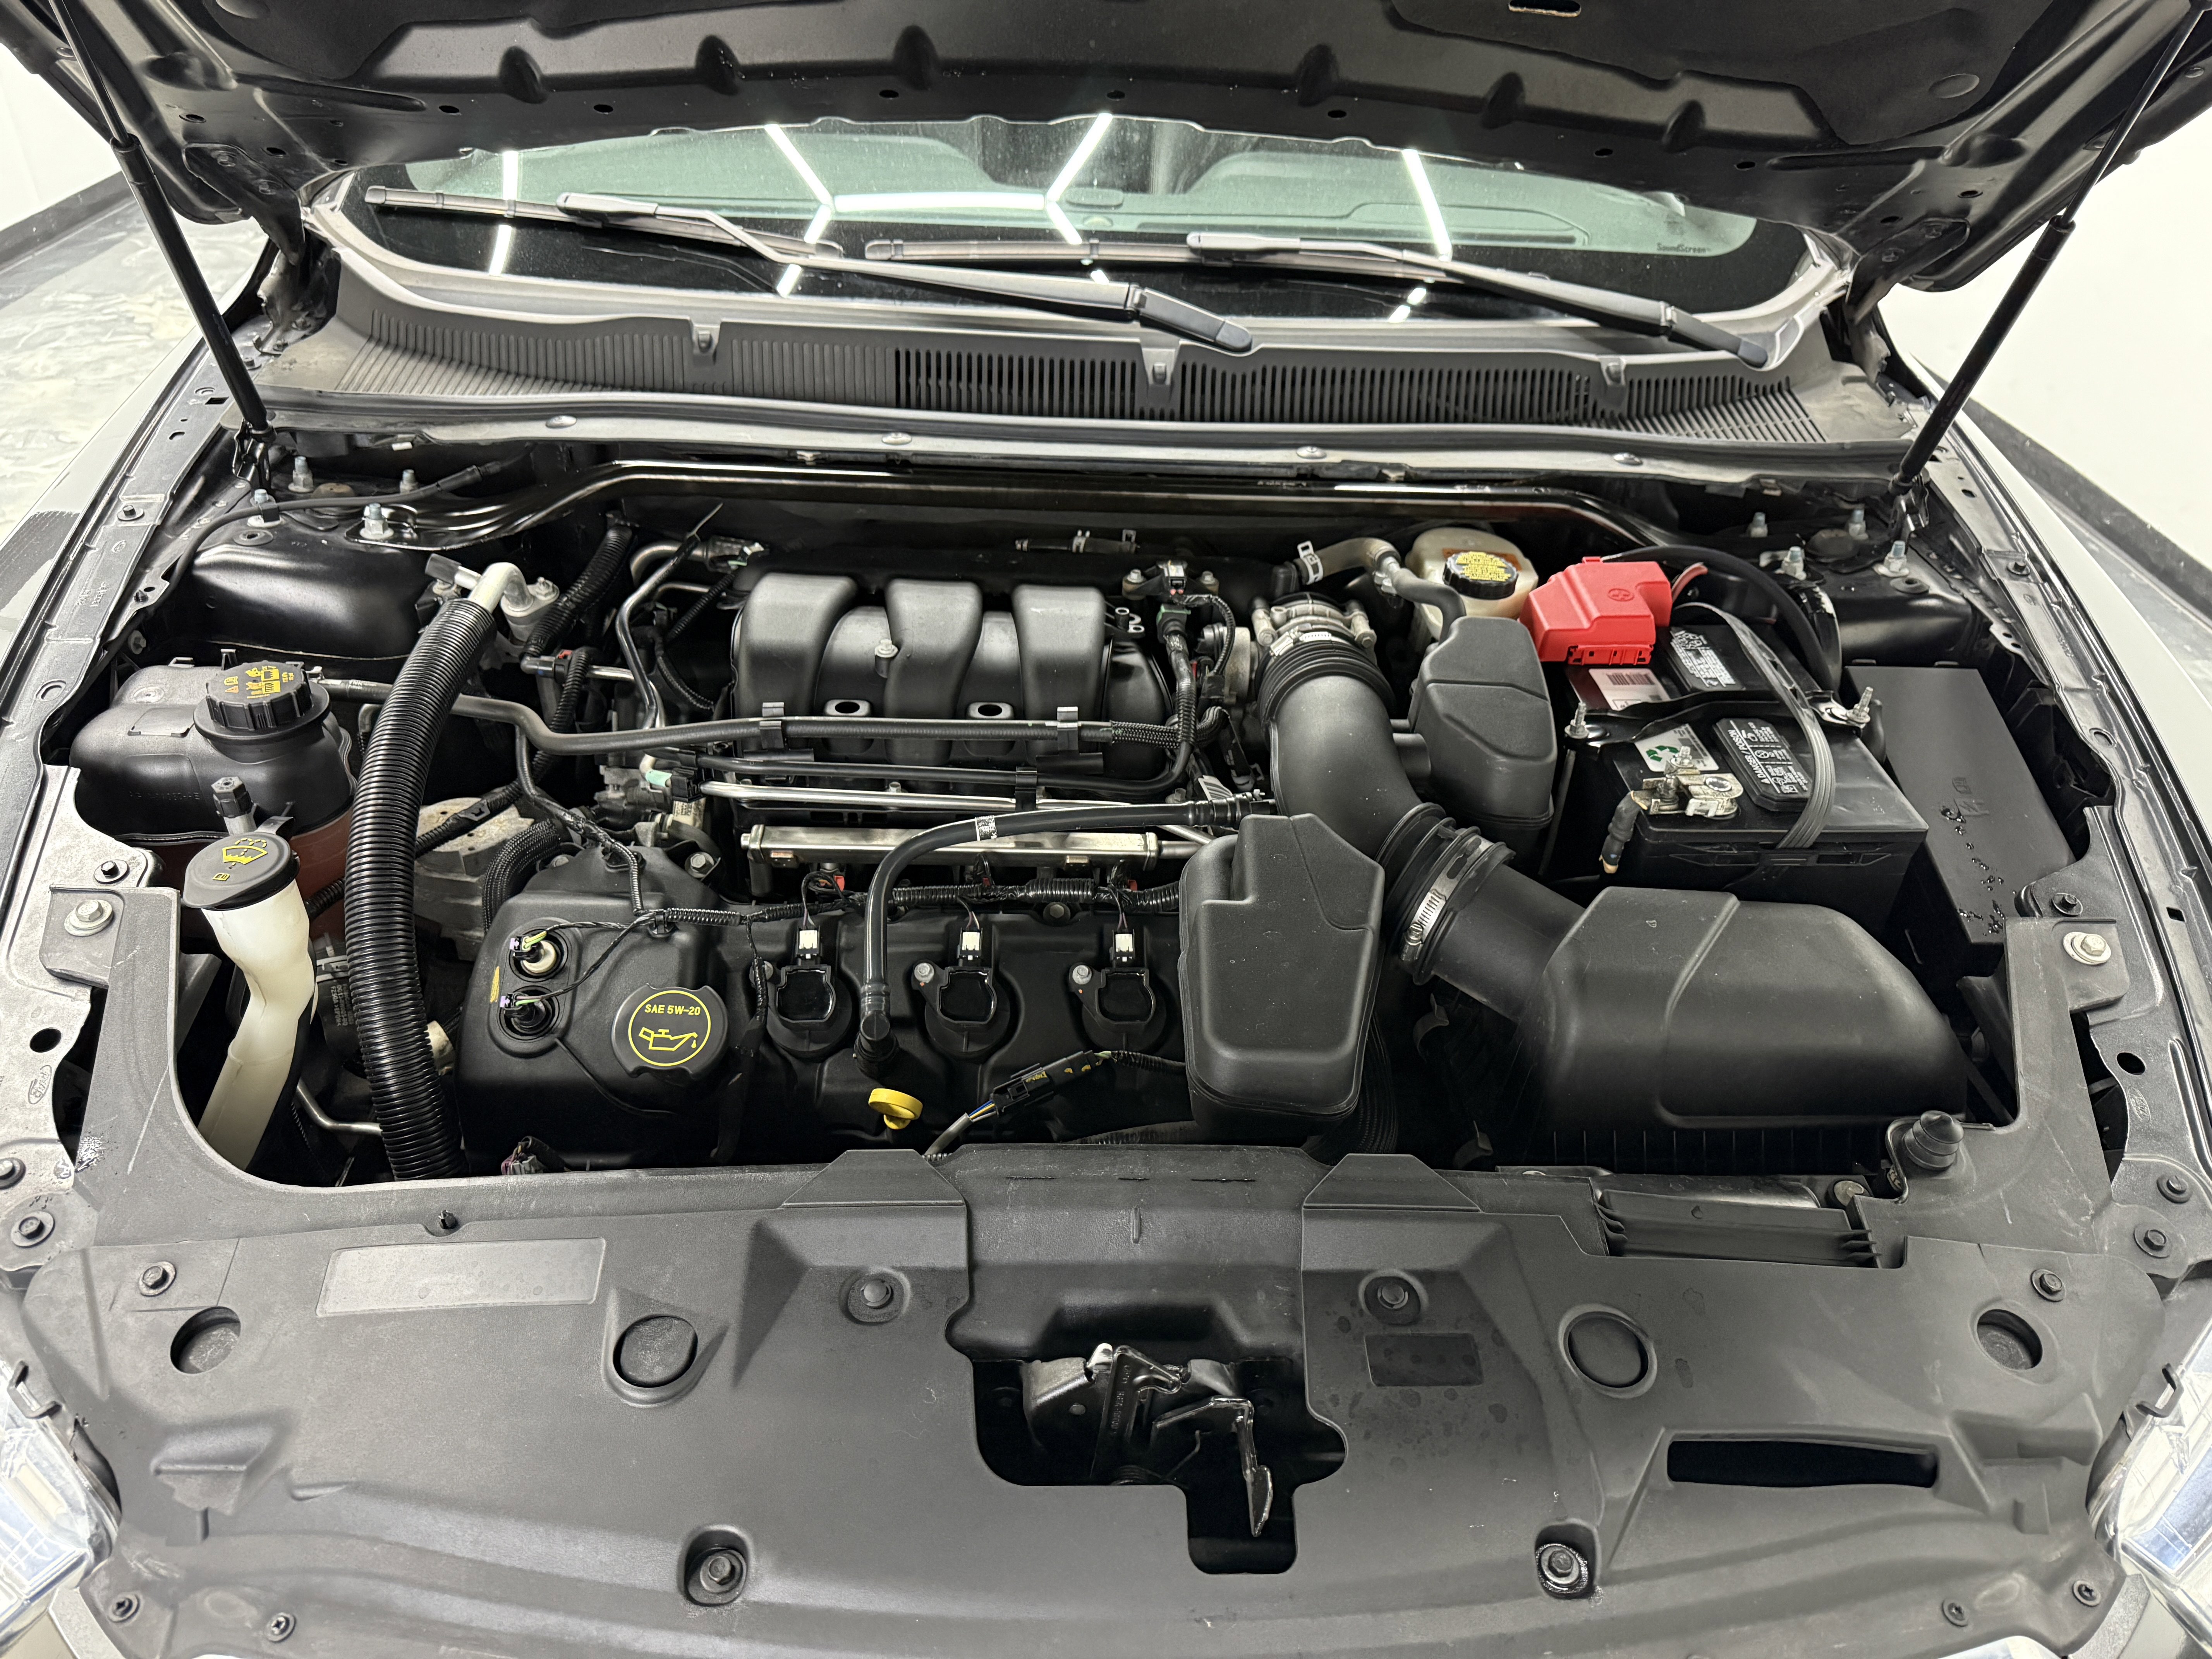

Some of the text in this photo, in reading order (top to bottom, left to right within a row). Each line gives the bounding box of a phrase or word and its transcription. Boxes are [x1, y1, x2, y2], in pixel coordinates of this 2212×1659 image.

[1728, 730, 1748, 750] POISON
[1745, 755, 1766, 778] DANGER
[644, 1004, 701, 1016] SAE 5W-20
